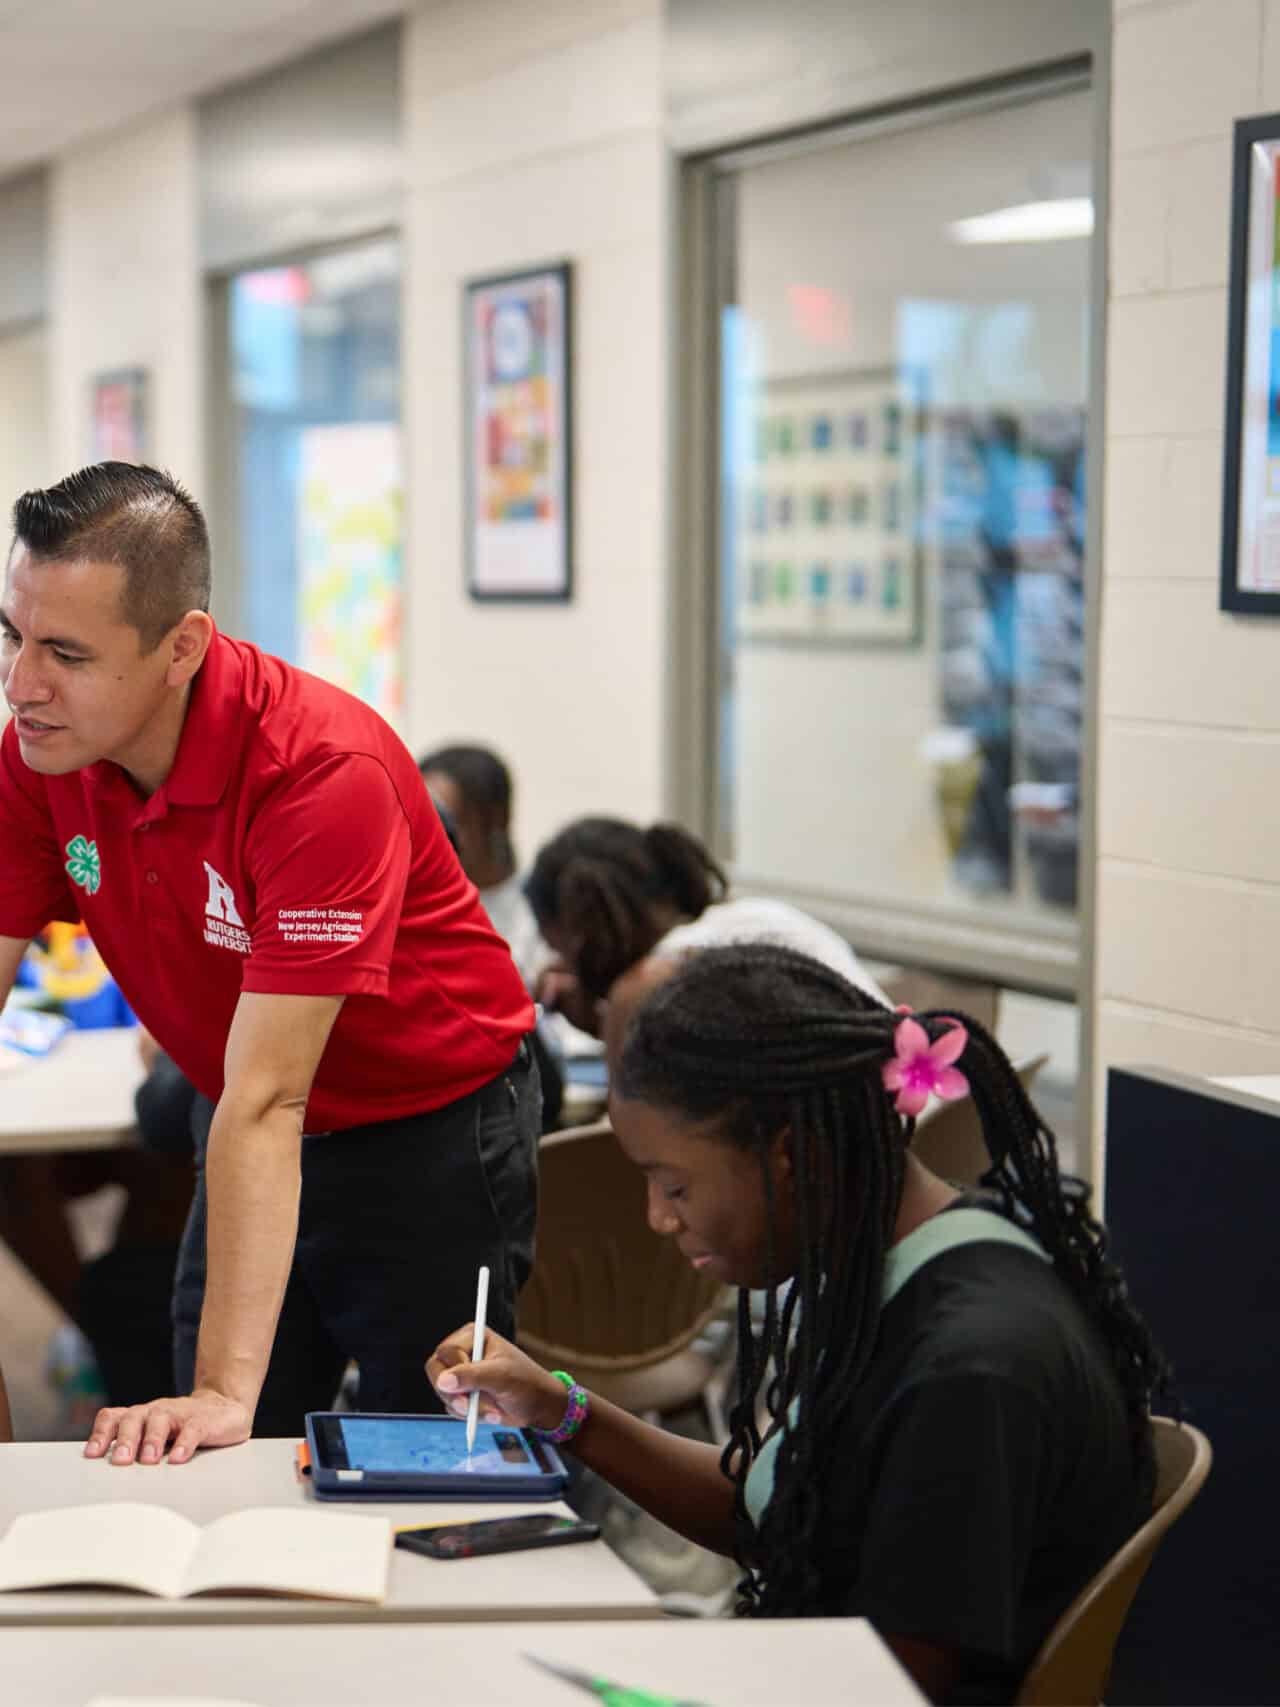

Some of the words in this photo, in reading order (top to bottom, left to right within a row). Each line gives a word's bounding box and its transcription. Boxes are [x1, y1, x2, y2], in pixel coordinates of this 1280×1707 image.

[203, 860, 245, 928] R
[278, 908, 327, 920] Cooperative
[328, 909, 362, 920] Extension
[206, 917, 252, 941] RUTGERS
[278, 922, 295, 931] New
[295, 922, 321, 932] Jersey
[203, 929, 253, 954] UNIVERSIT
[284, 931, 333, 943] Experiment
[333, 932, 360, 942] Station
